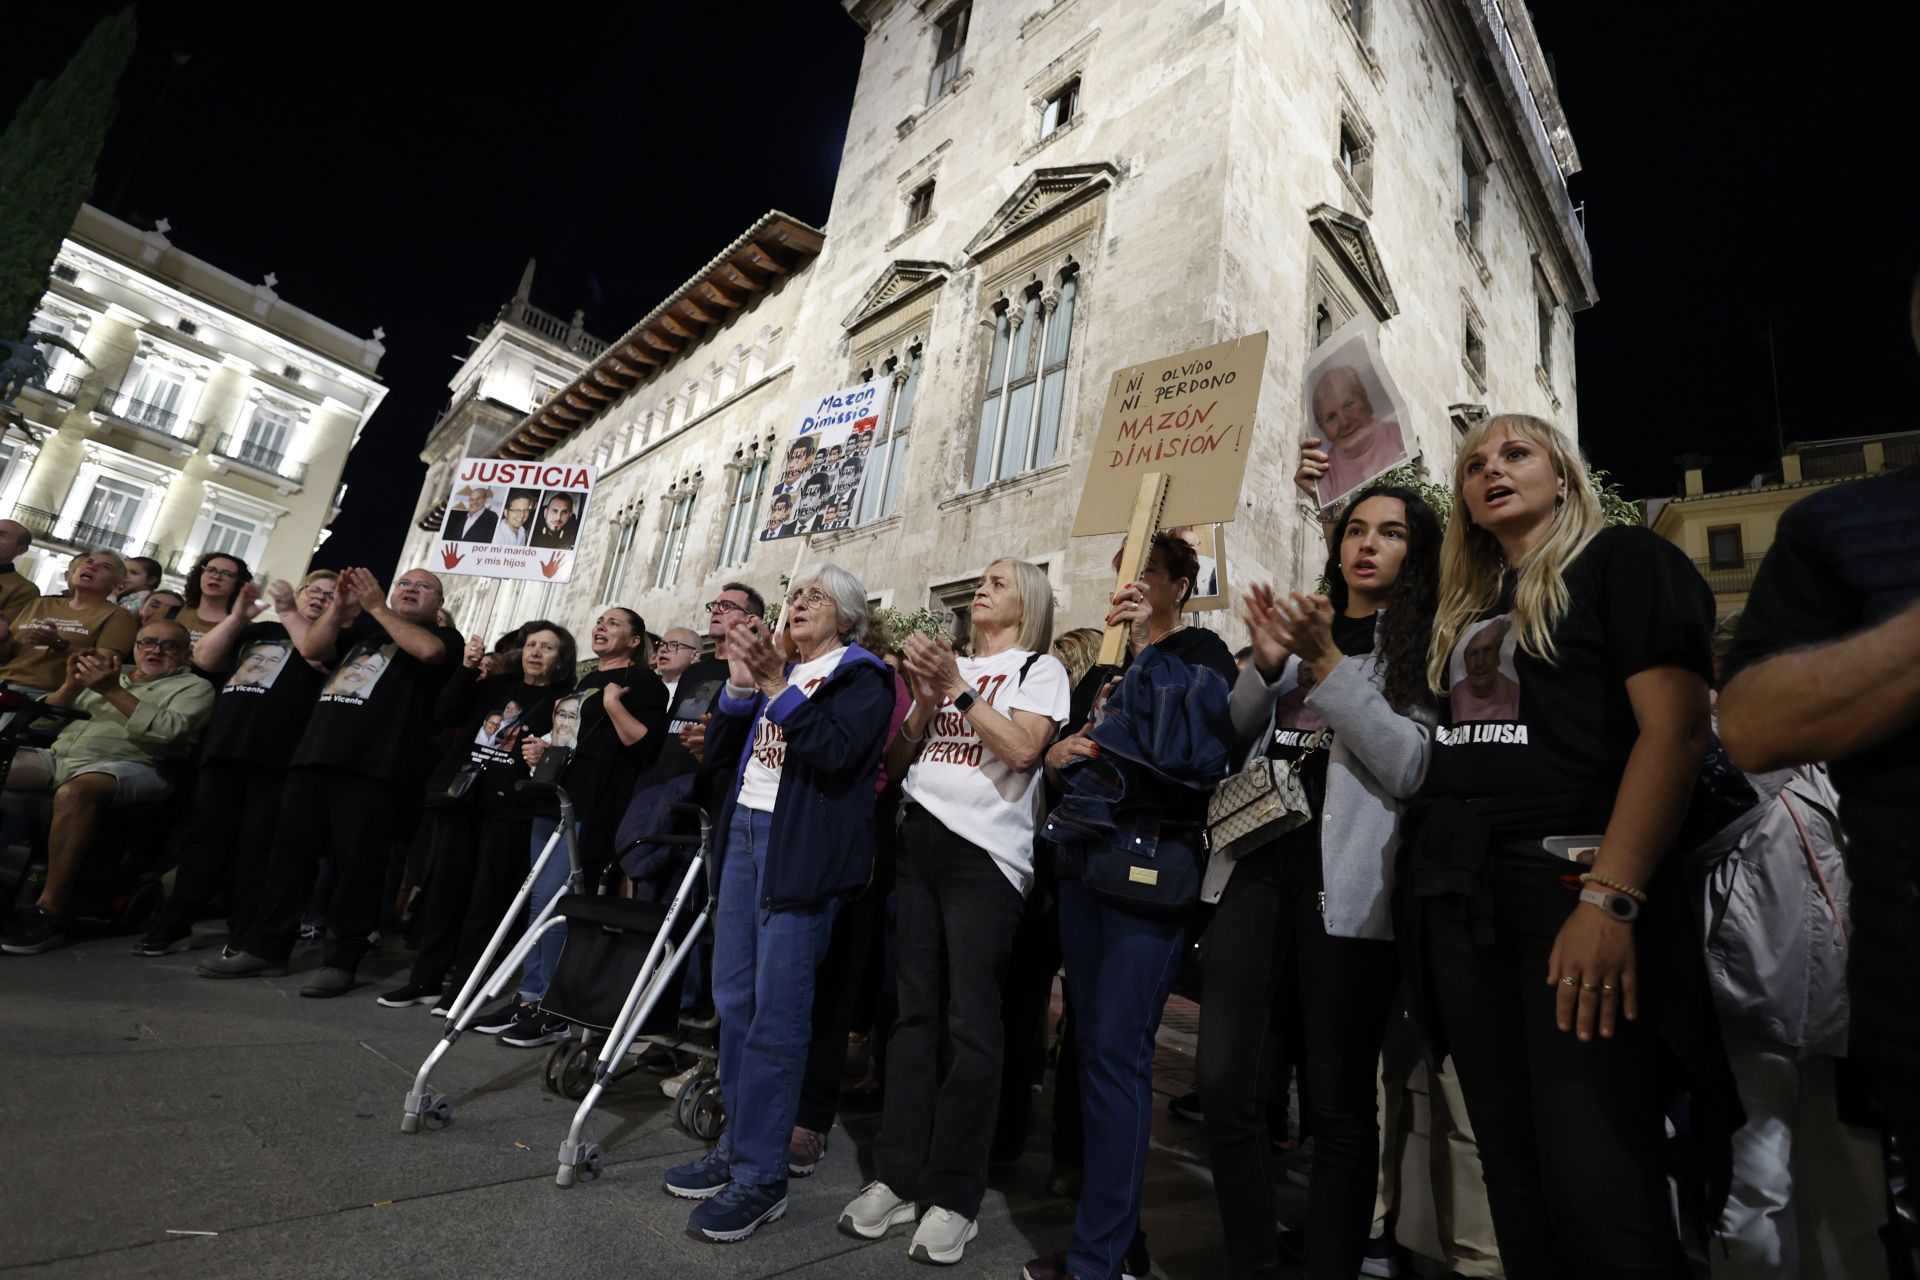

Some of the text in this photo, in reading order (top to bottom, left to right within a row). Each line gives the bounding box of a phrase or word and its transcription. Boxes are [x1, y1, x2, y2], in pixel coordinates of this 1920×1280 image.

[817, 383, 876, 414] Mazón
[1154, 371, 1236, 404] PERDONO
[1117, 401, 1218, 442] MAZÓN
[461, 462, 590, 489] JUSTICIA
[472, 545, 488, 553] por
[504, 547, 537, 556] marido
[476, 557, 526, 568] y mis hijos
[236, 685, 265, 695] Vicente
[333, 694, 364, 706] Vicente
[1473, 723, 1529, 745] LUISA
[923, 740, 984, 767] PERDÓ
